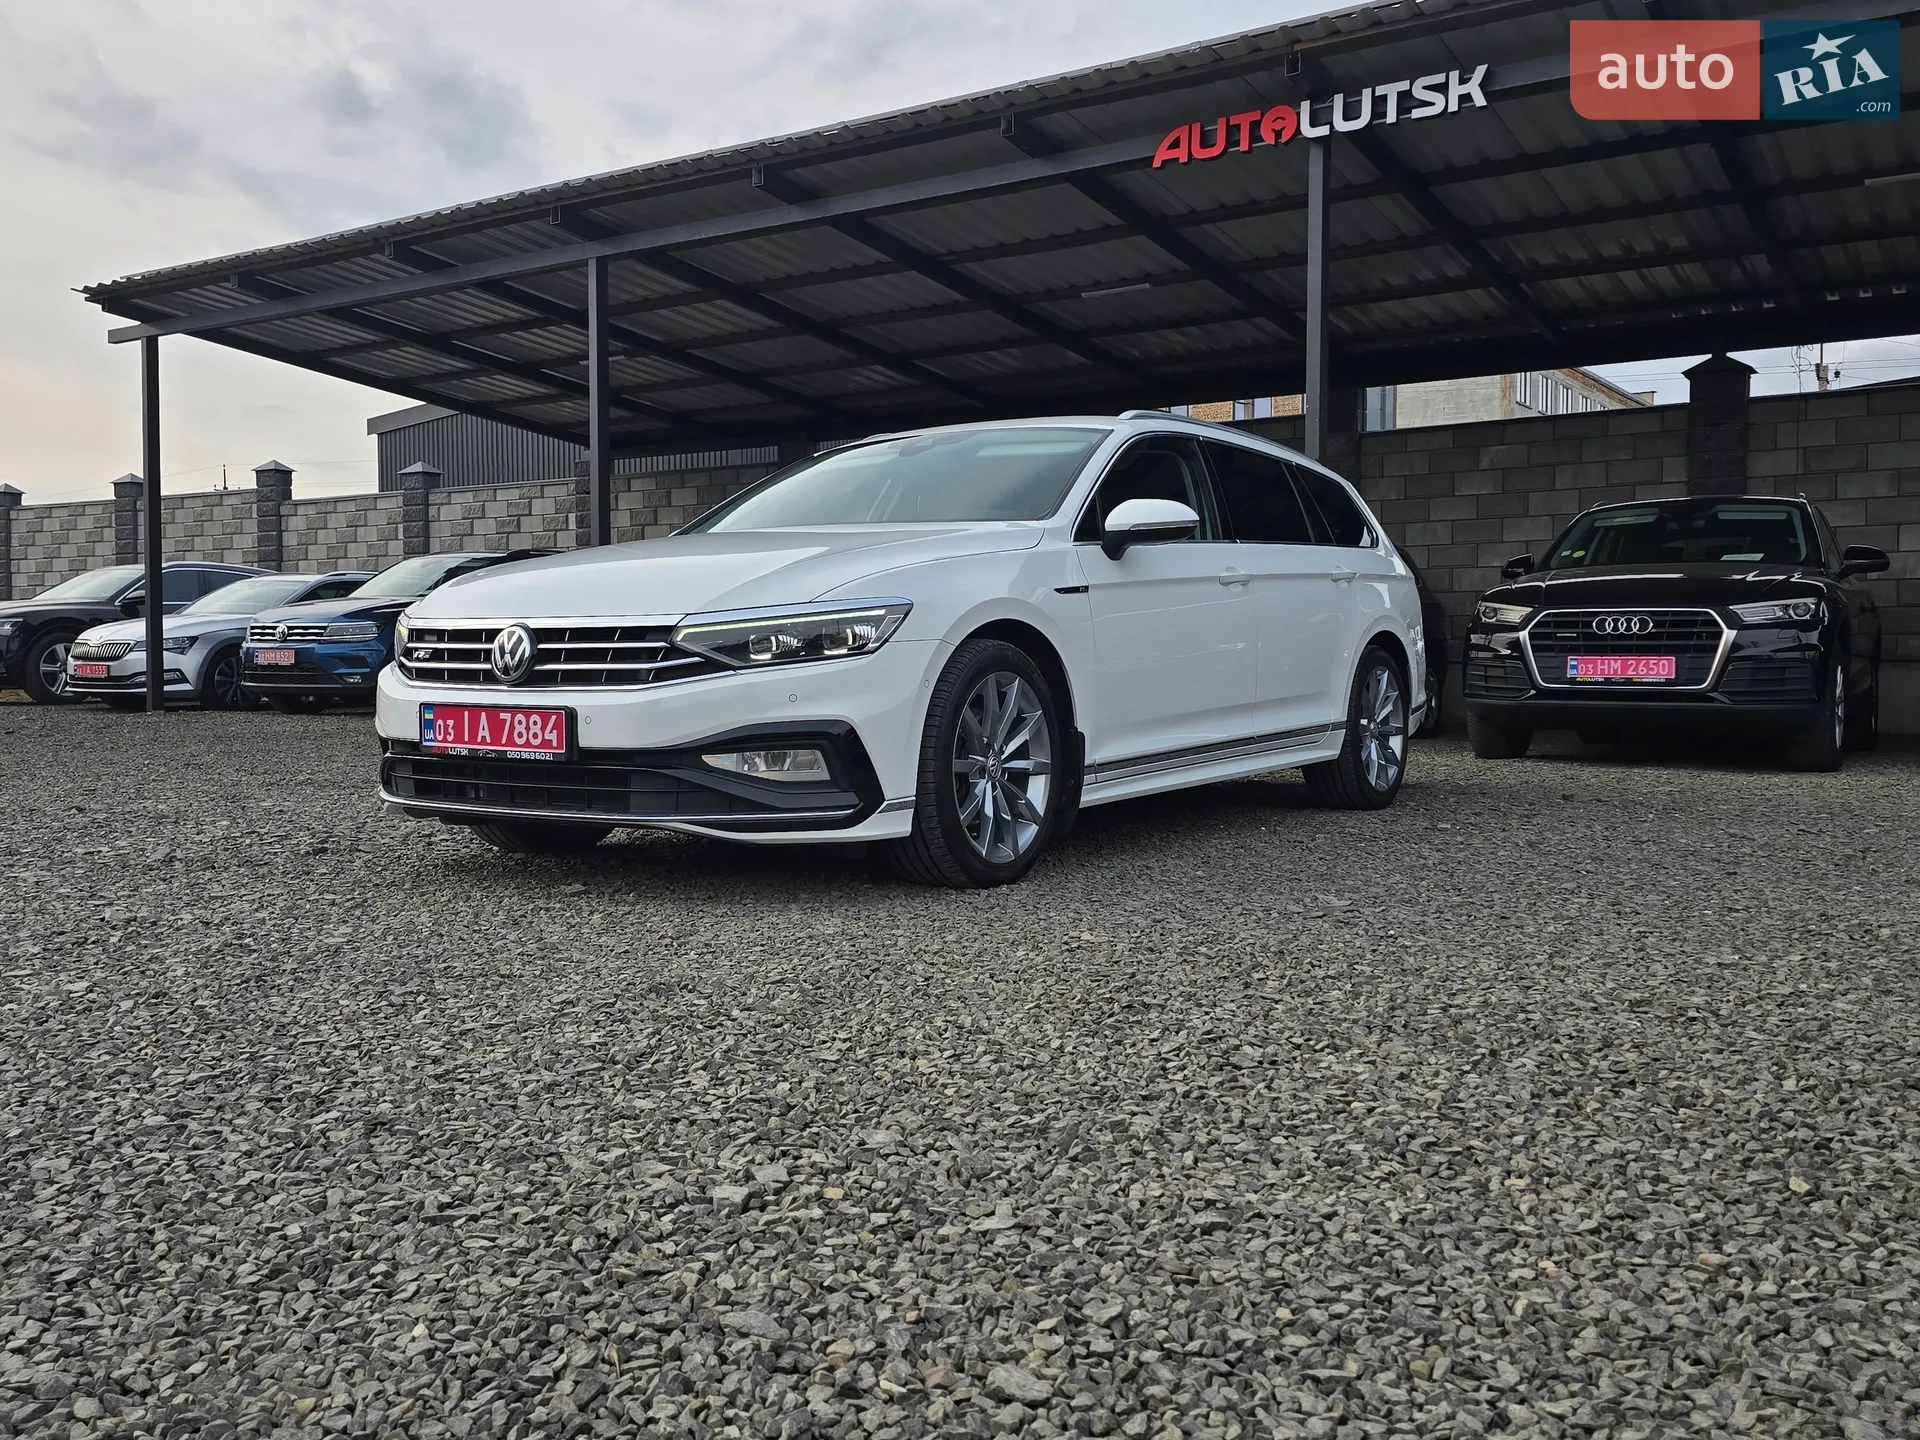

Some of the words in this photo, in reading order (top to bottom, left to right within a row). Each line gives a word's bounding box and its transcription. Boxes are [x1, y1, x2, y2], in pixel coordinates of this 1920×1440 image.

[1578, 664, 1594, 675] 03
[1597, 660, 1621, 675] HM
[1627, 660, 1669, 675] 2650
[424, 729, 434, 740] UA
[436, 719, 455, 742] 03
[464, 711, 491, 743] IA
[500, 712, 558, 747] 7884
